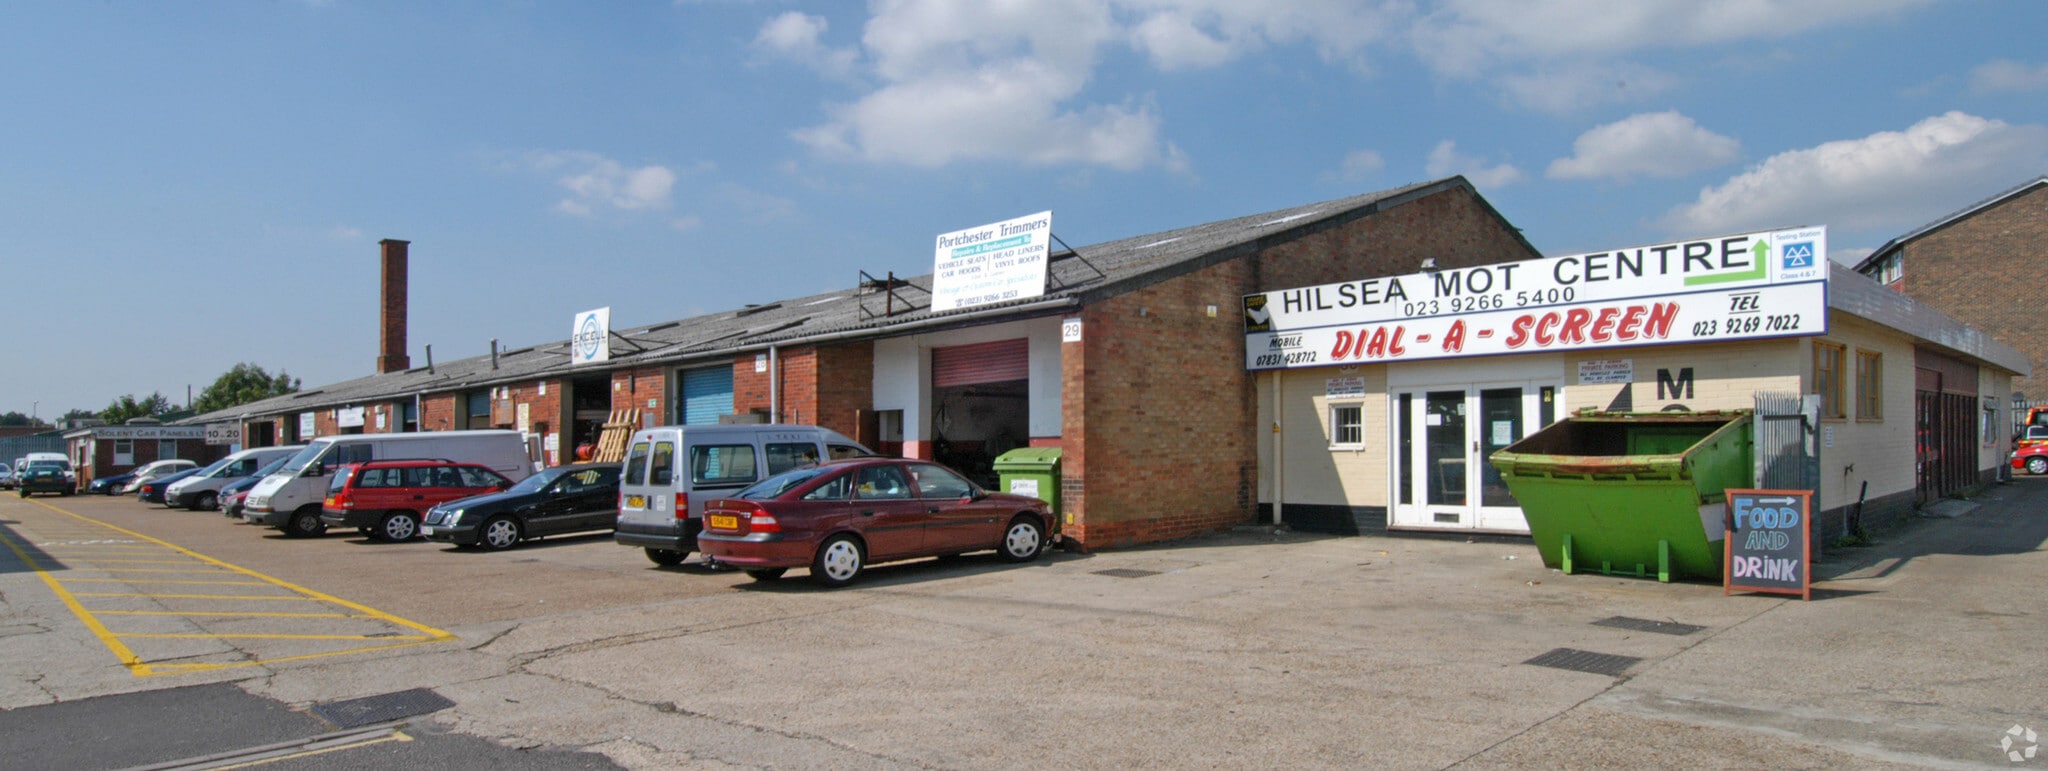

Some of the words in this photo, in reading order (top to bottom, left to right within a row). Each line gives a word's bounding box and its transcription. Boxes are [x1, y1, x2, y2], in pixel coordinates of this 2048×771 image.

[939, 229, 993, 248] Portchester
[999, 218, 1048, 237] Trimmers
[993, 250, 1015, 260] HEAD
[1017, 244, 1045, 255] LINERS
[938, 260, 964, 270] VEHICLE
[967, 256, 987, 265] SEATS
[995, 260, 1015, 269] VINYL
[1017, 255, 1041, 265] ROOFS
[941, 269, 954, 278] CAR
[958, 266, 981, 275] HOODS
[1282, 279, 1409, 314] HILSEA
[1433, 263, 1520, 298] MOT
[1553, 236, 1750, 285] CENTRE
[964, 295, 982, 307] (023)
[983, 293, 1000, 302] 9266
[1002, 290, 1018, 299] 3253
[1404, 300, 1440, 317] 023
[1451, 294, 1503, 313] 9266
[1516, 286, 1575, 307] 5400
[1729, 295, 1760, 311] TEL
[1065, 324, 1080, 337] 29
[1331, 325, 1405, 361] DIAL
[1442, 319, 1467, 353] A
[1504, 300, 1681, 350] SCREEN
[1692, 320, 1717, 337] 023
[1726, 316, 1760, 335] 9269
[1765, 314, 1801, 331] 7022
[574, 330, 607, 344] EXCELL
[1269, 336, 1304, 348] MOBILE
[1256, 353, 1281, 367] 07831
[1283, 351, 1317, 365] 428712
[99, 429, 134, 438] SOLENT
[136, 429, 156, 437] CAR
[160, 429, 194, 437] PANELS
[207, 430, 219, 438] 10
[226, 430, 240, 438] 20
[1735, 498, 1799, 529] FOOD
[1744, 530, 1789, 550] AND
[1733, 555, 1798, 582] DRINK
